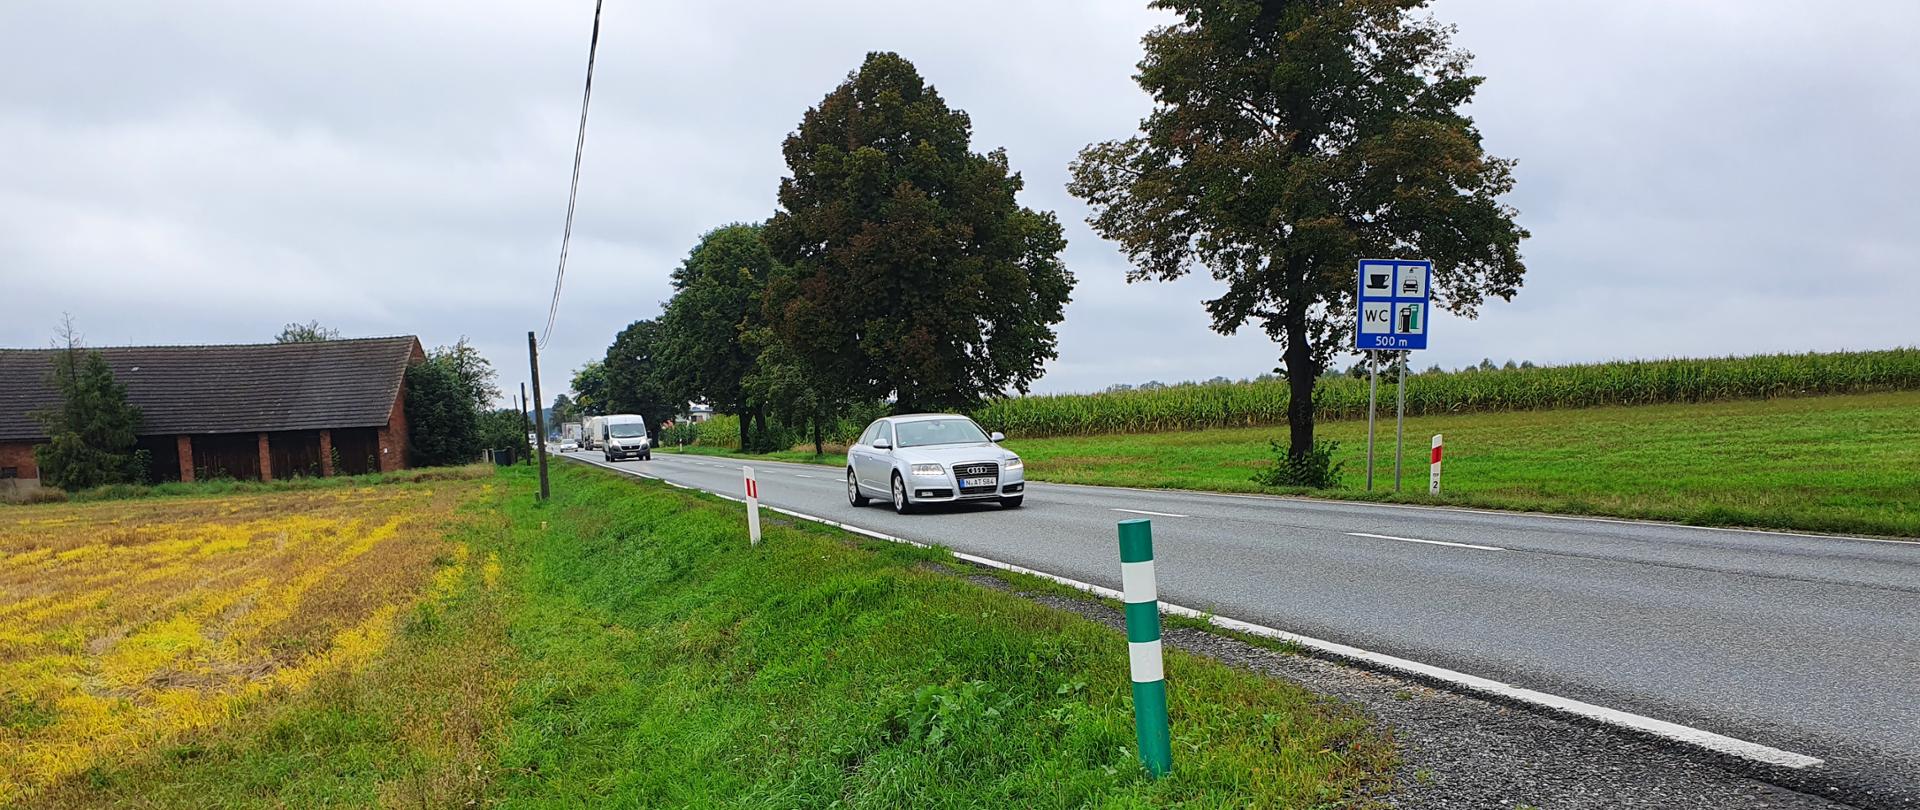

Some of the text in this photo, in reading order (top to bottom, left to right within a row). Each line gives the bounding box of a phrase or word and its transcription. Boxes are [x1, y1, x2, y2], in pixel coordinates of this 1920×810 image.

[1365, 309, 1388, 322] WC
[1375, 336, 1407, 347] 500 m
